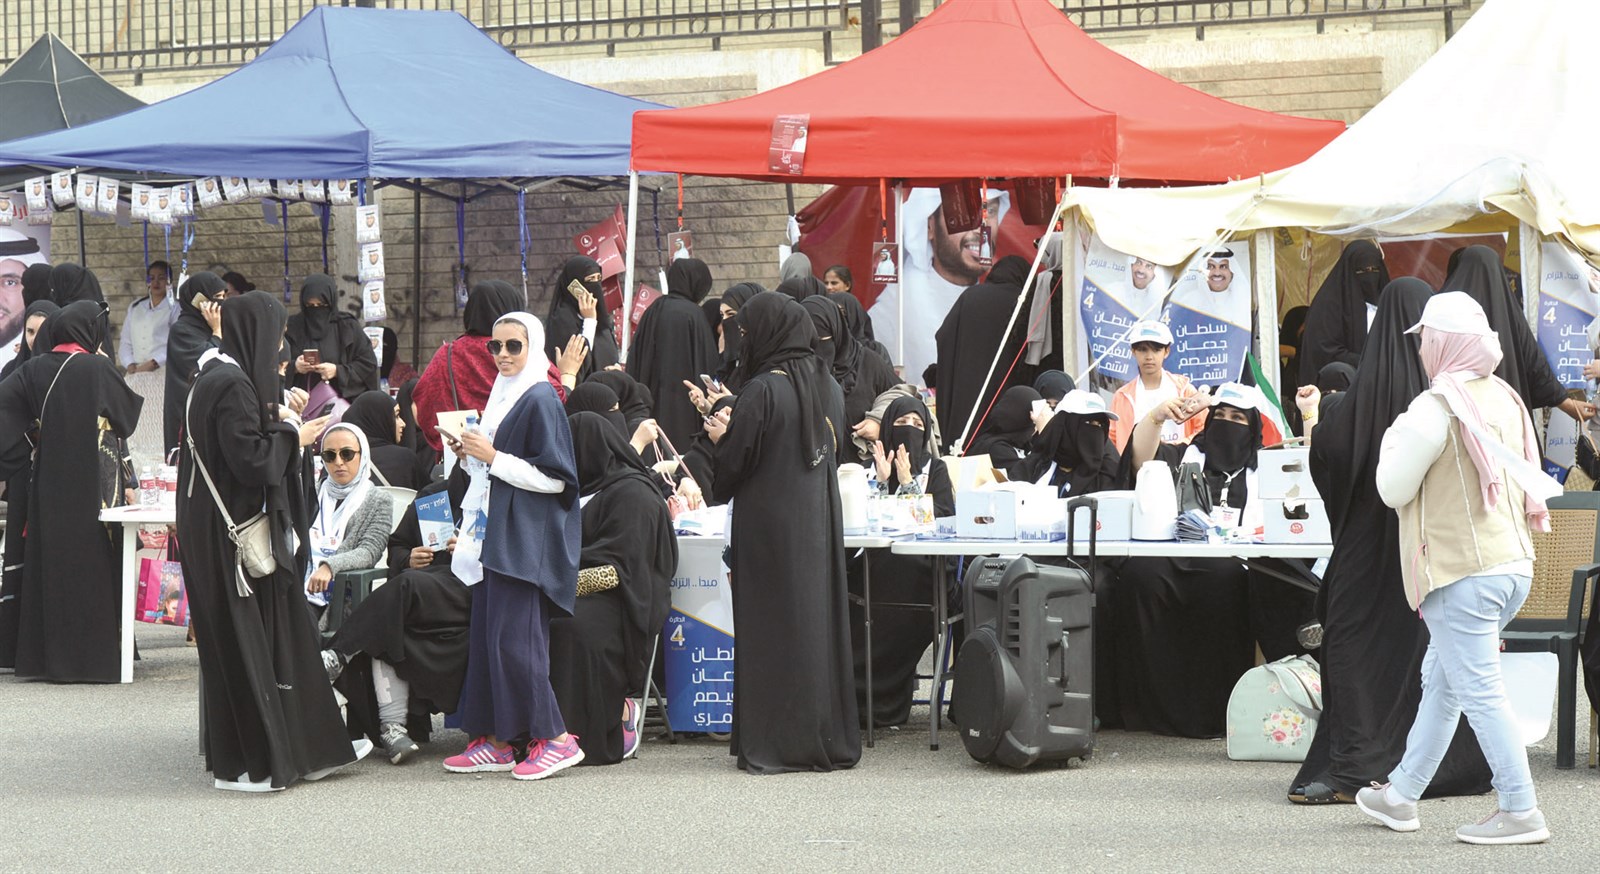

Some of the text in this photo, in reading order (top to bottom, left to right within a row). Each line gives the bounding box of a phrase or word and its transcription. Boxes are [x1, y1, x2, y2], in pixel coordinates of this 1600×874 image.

[1083, 292, 1094, 309] 4
[1543, 306, 1556, 324] 4
[1176, 323, 1228, 338] سلطان
[670, 624, 686, 646] 4
[692, 646, 734, 663] لطان
